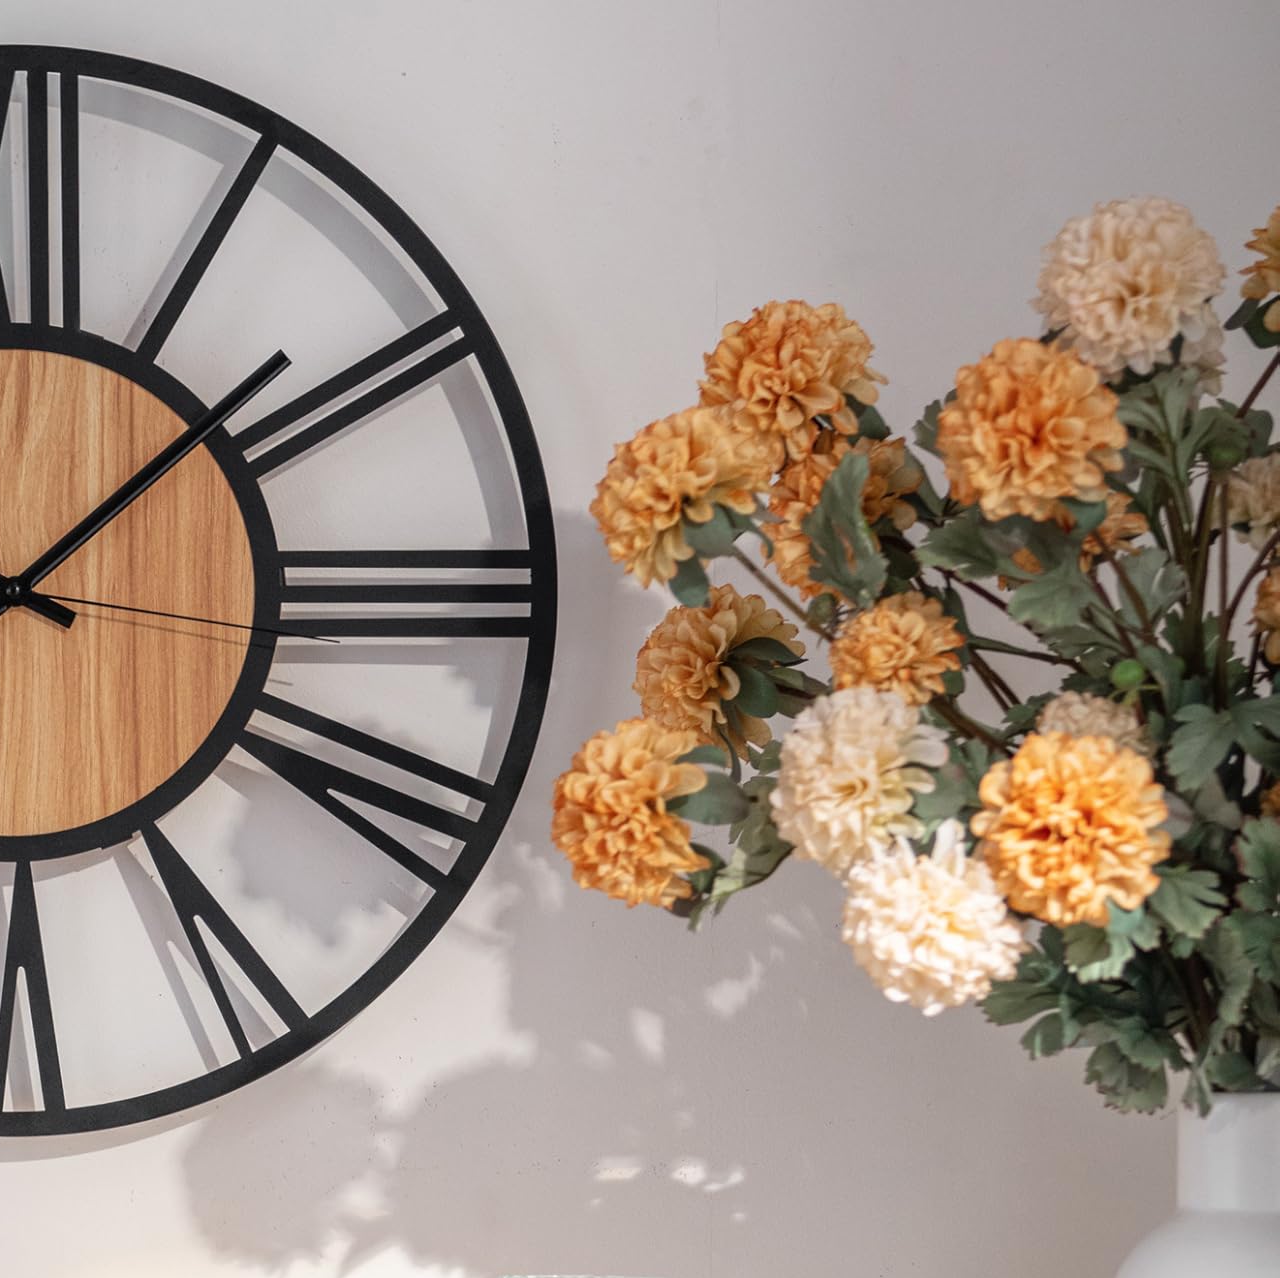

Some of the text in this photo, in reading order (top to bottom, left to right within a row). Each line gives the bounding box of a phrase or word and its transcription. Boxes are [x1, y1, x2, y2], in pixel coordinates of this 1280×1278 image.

[135, 134, 278, 363] I
[232, 308, 475, 479] II
[276, 549, 531, 638] III
[140, 828, 310, 1058] V
